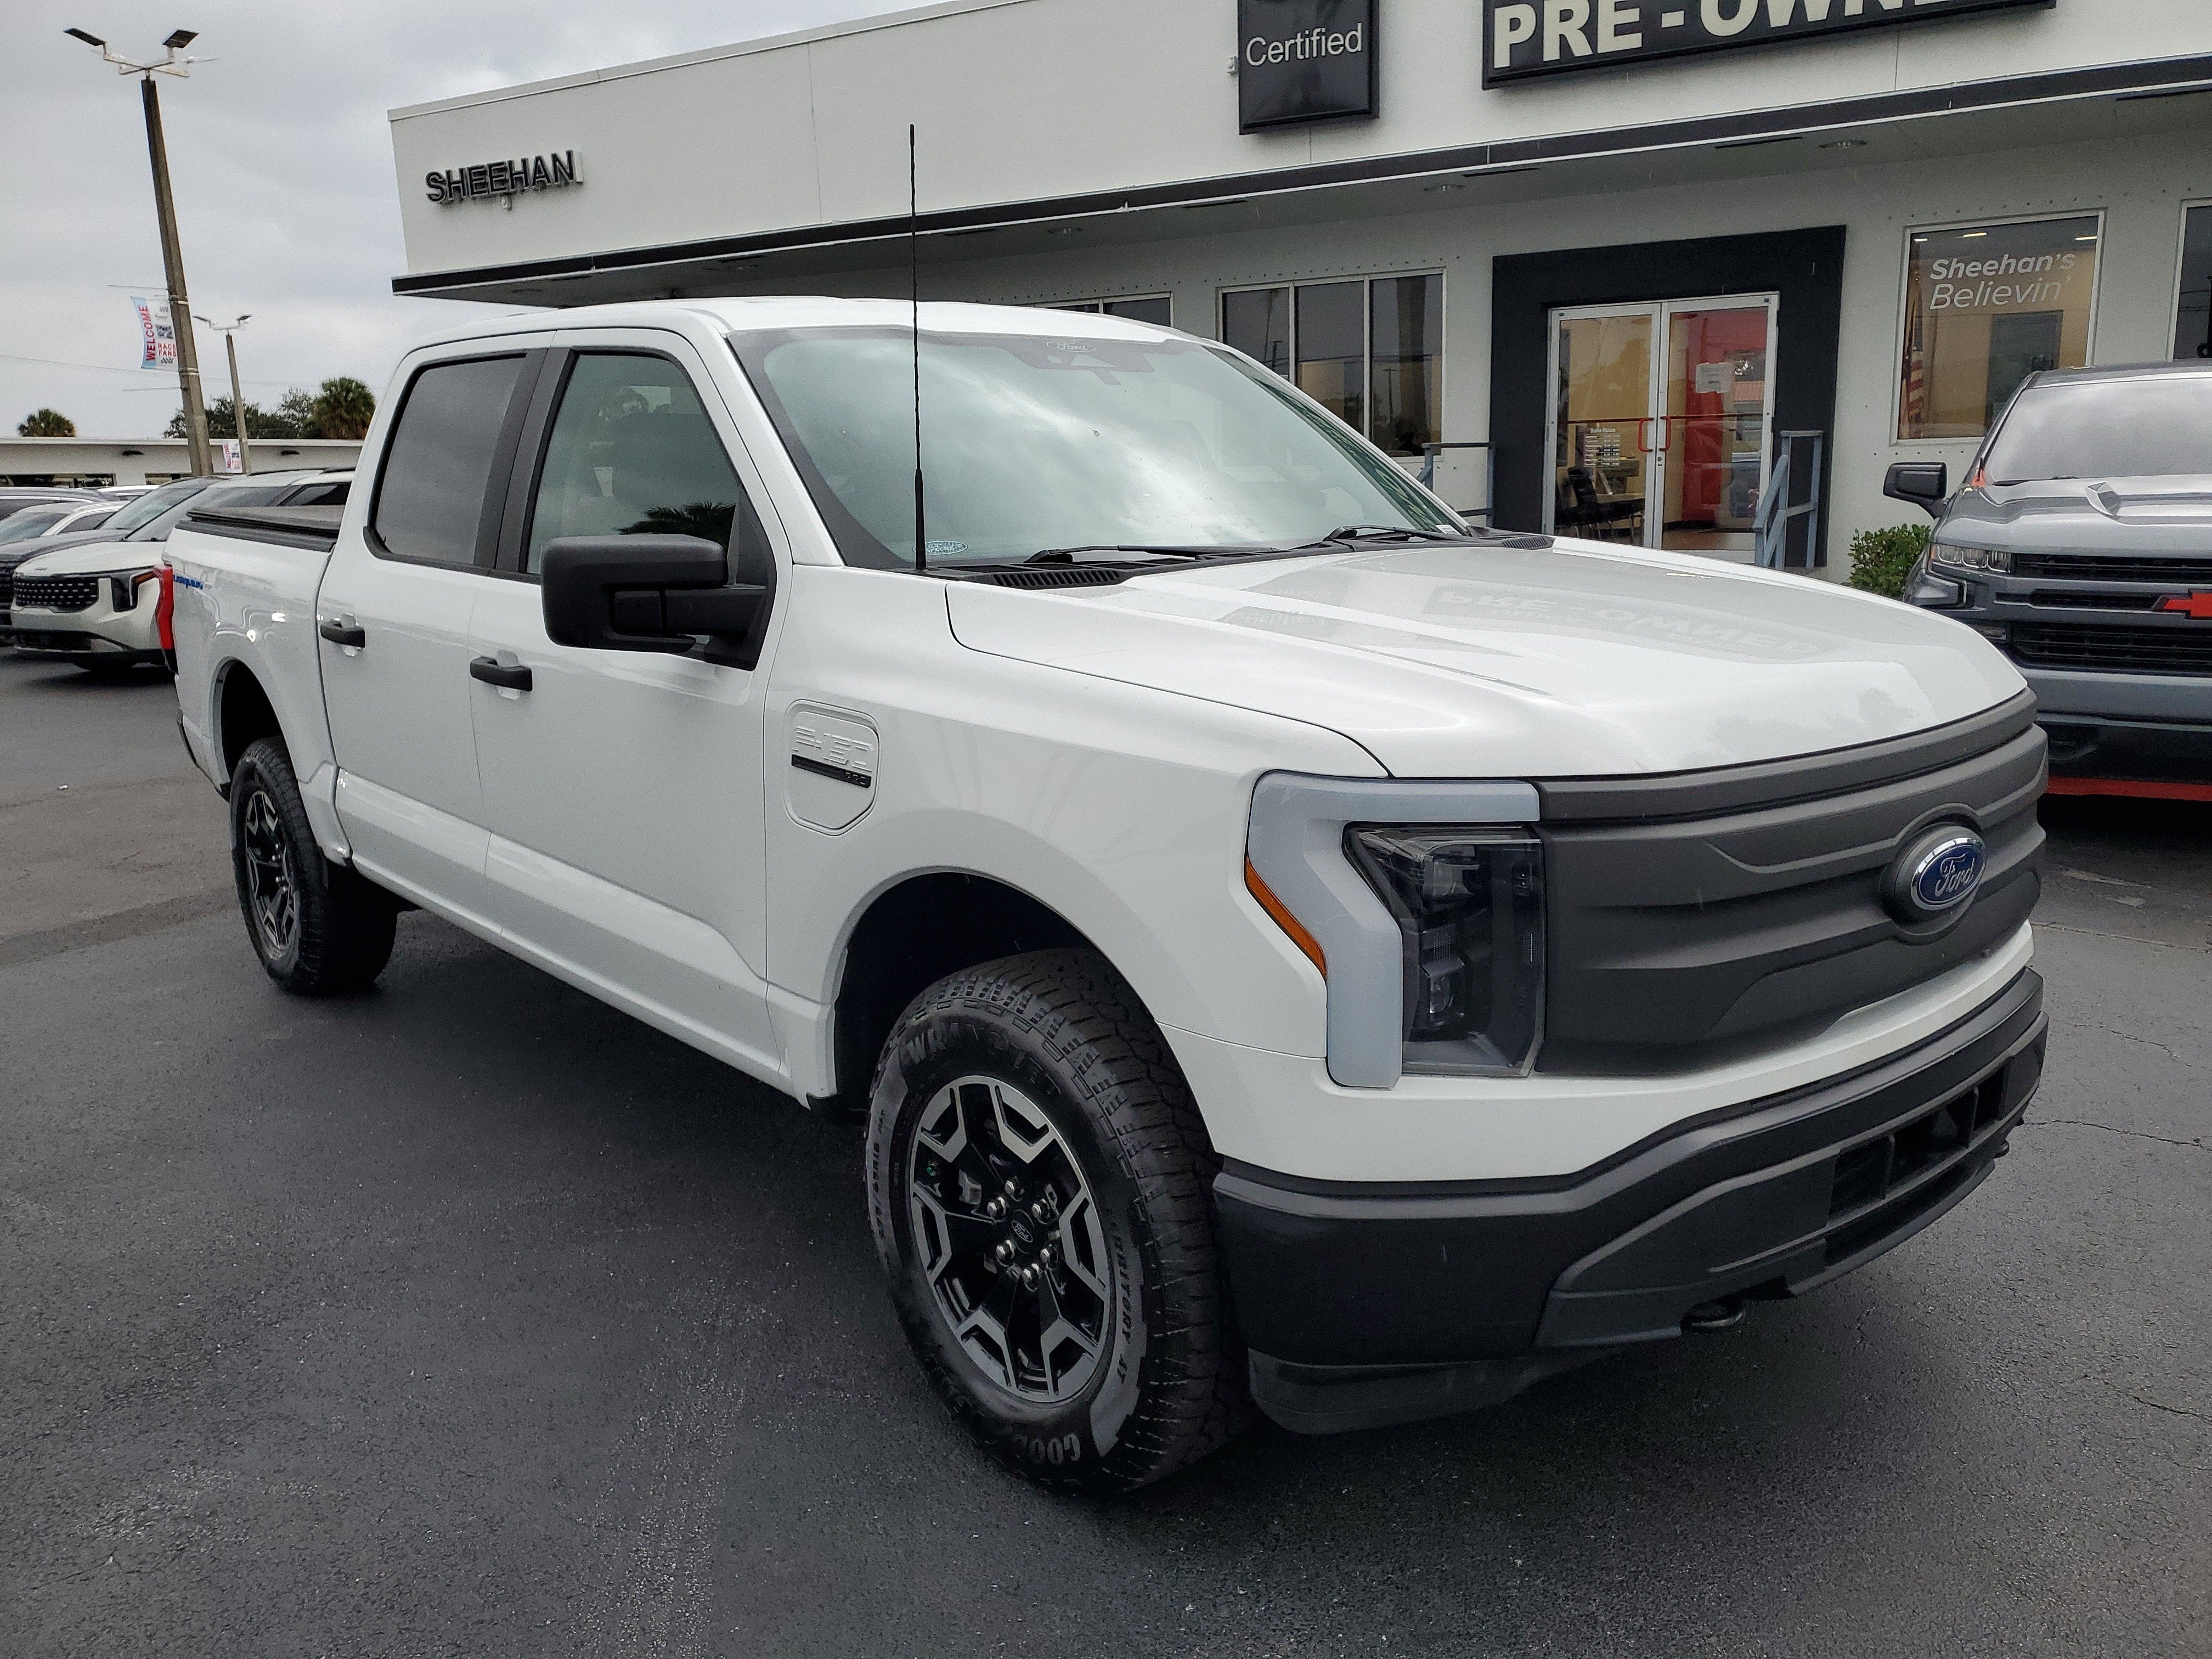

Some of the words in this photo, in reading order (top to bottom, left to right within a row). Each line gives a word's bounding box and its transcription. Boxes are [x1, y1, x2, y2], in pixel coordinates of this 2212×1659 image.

[1246, 22, 1363, 66] Certified
[425, 150, 576, 201] SHEEHAN
[1929, 252, 2076, 280] Sheehan's
[1929, 276, 2073, 310] Believin'
[138, 305, 156, 361] WELCOME
[1934, 850, 1977, 898] Ford
